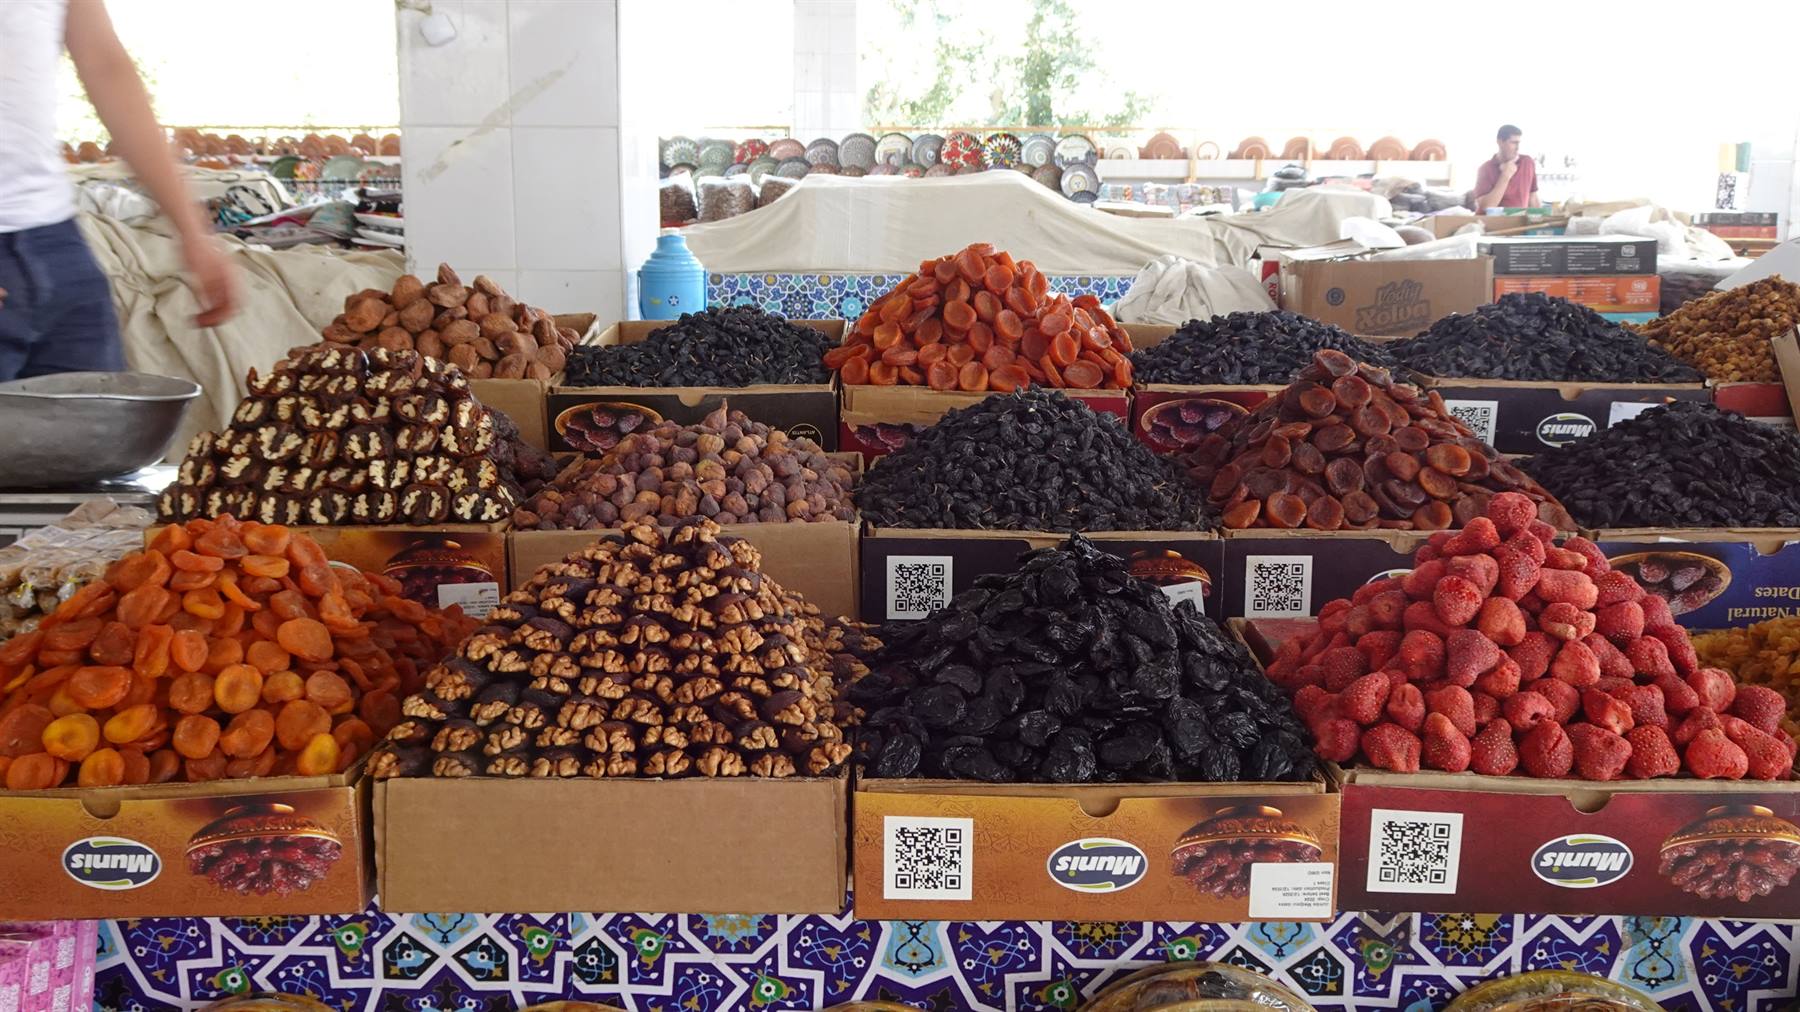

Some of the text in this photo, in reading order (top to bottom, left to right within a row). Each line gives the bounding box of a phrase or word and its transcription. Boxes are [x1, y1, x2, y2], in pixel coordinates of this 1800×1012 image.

[1541, 424, 1593, 437] Munis
[1755, 586, 1800, 600] Dates
[1727, 606, 1790, 622] Natural
[70, 853, 153, 875] Munis
[1055, 855, 1141, 877] Munis
[1540, 852, 1627, 873] Munis
